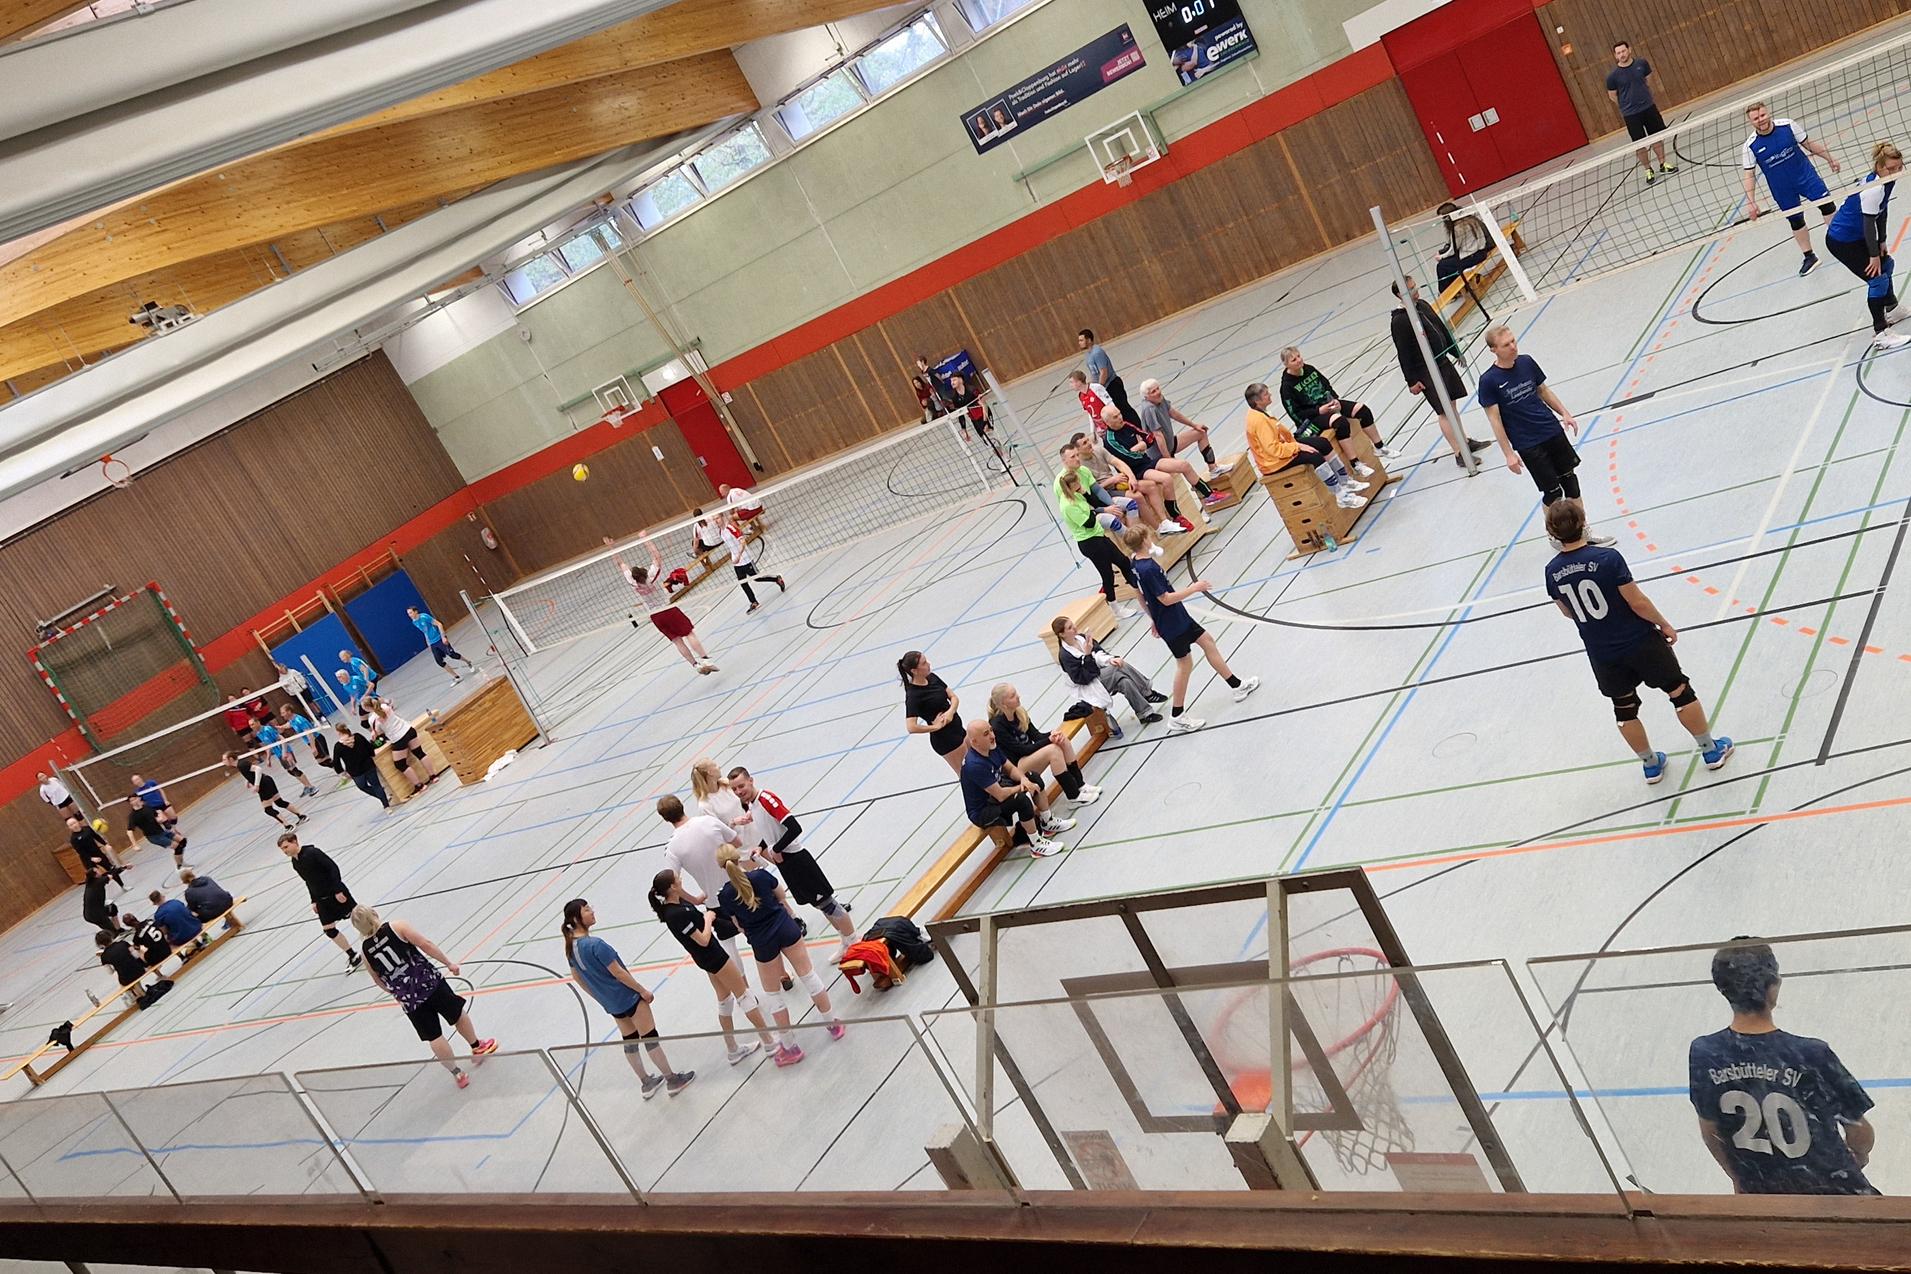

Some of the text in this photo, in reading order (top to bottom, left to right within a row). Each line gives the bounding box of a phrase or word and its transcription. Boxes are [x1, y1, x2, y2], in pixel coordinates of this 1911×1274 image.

[1152, 2, 1177, 22] HEIM
[1206, 29, 1248, 62] ewerk
[1587, 561, 1599, 573] SV
[1557, 579, 1609, 623] 10
[147, 926, 163, 942] 5
[373, 945, 402, 973] 11
[1708, 1062, 1802, 1088] Barsbütteler SV
[1720, 1090, 1812, 1159] 20
